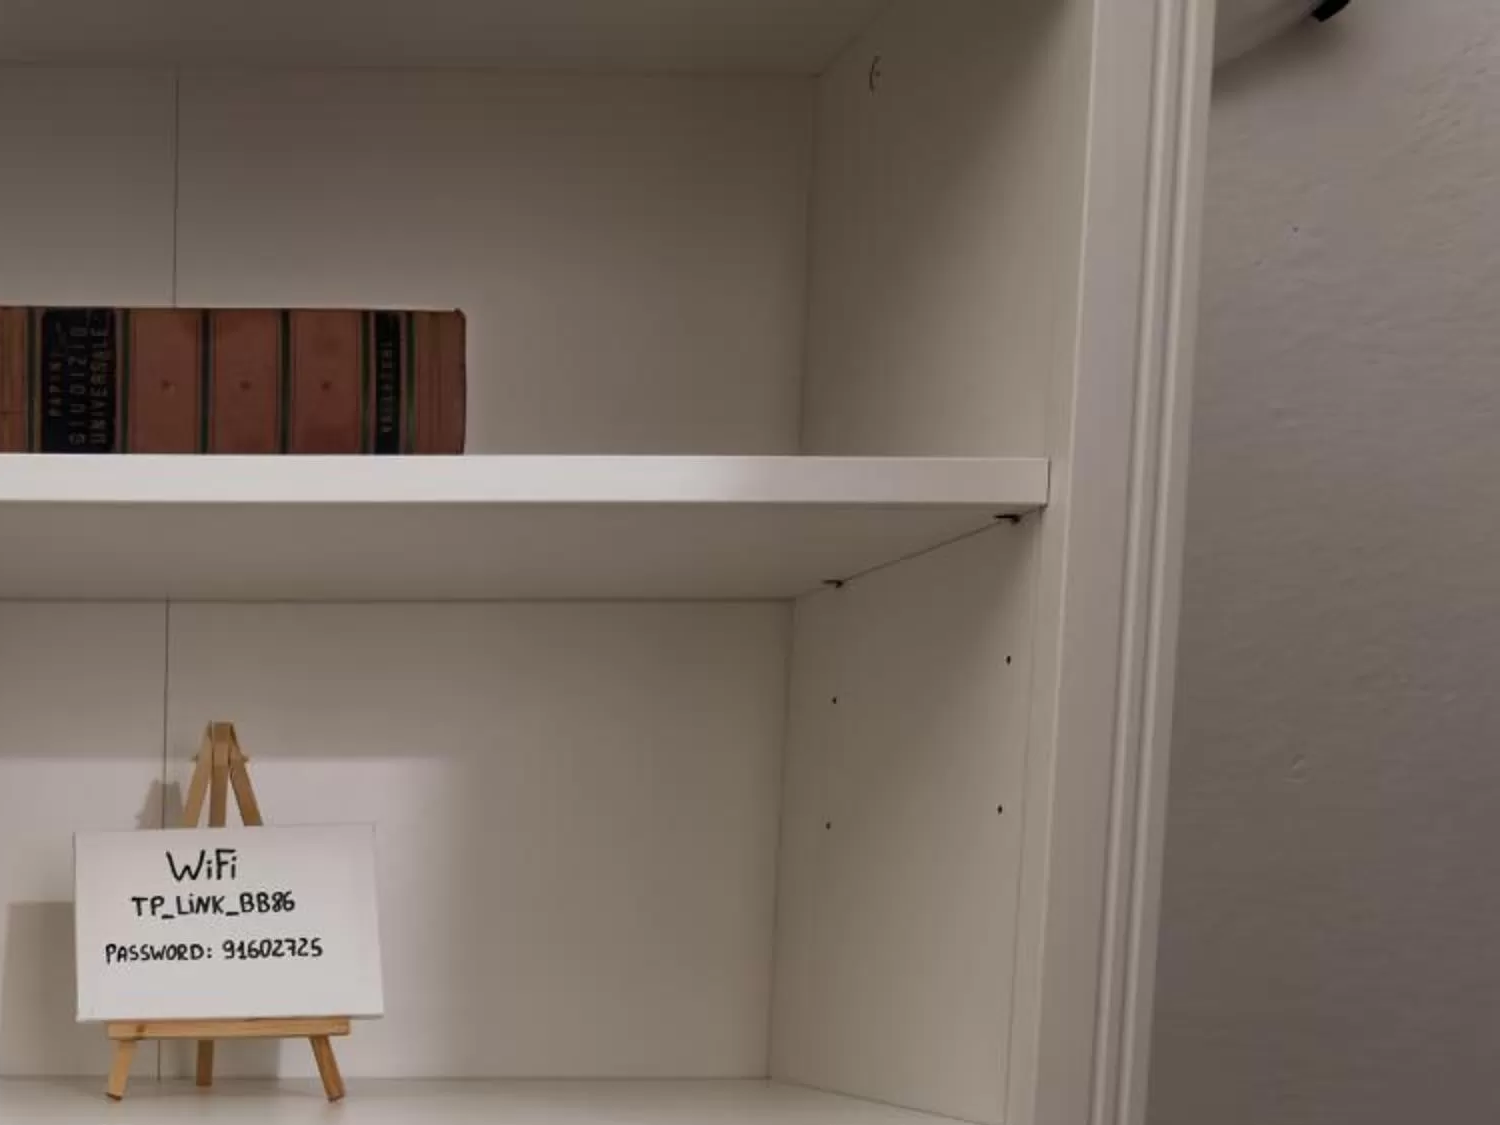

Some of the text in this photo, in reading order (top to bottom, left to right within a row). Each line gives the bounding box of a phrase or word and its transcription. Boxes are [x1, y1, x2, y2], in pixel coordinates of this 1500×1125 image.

[166, 849, 238, 881] WiFi
[105, 938, 323, 964] PASSWORD: 91602725
